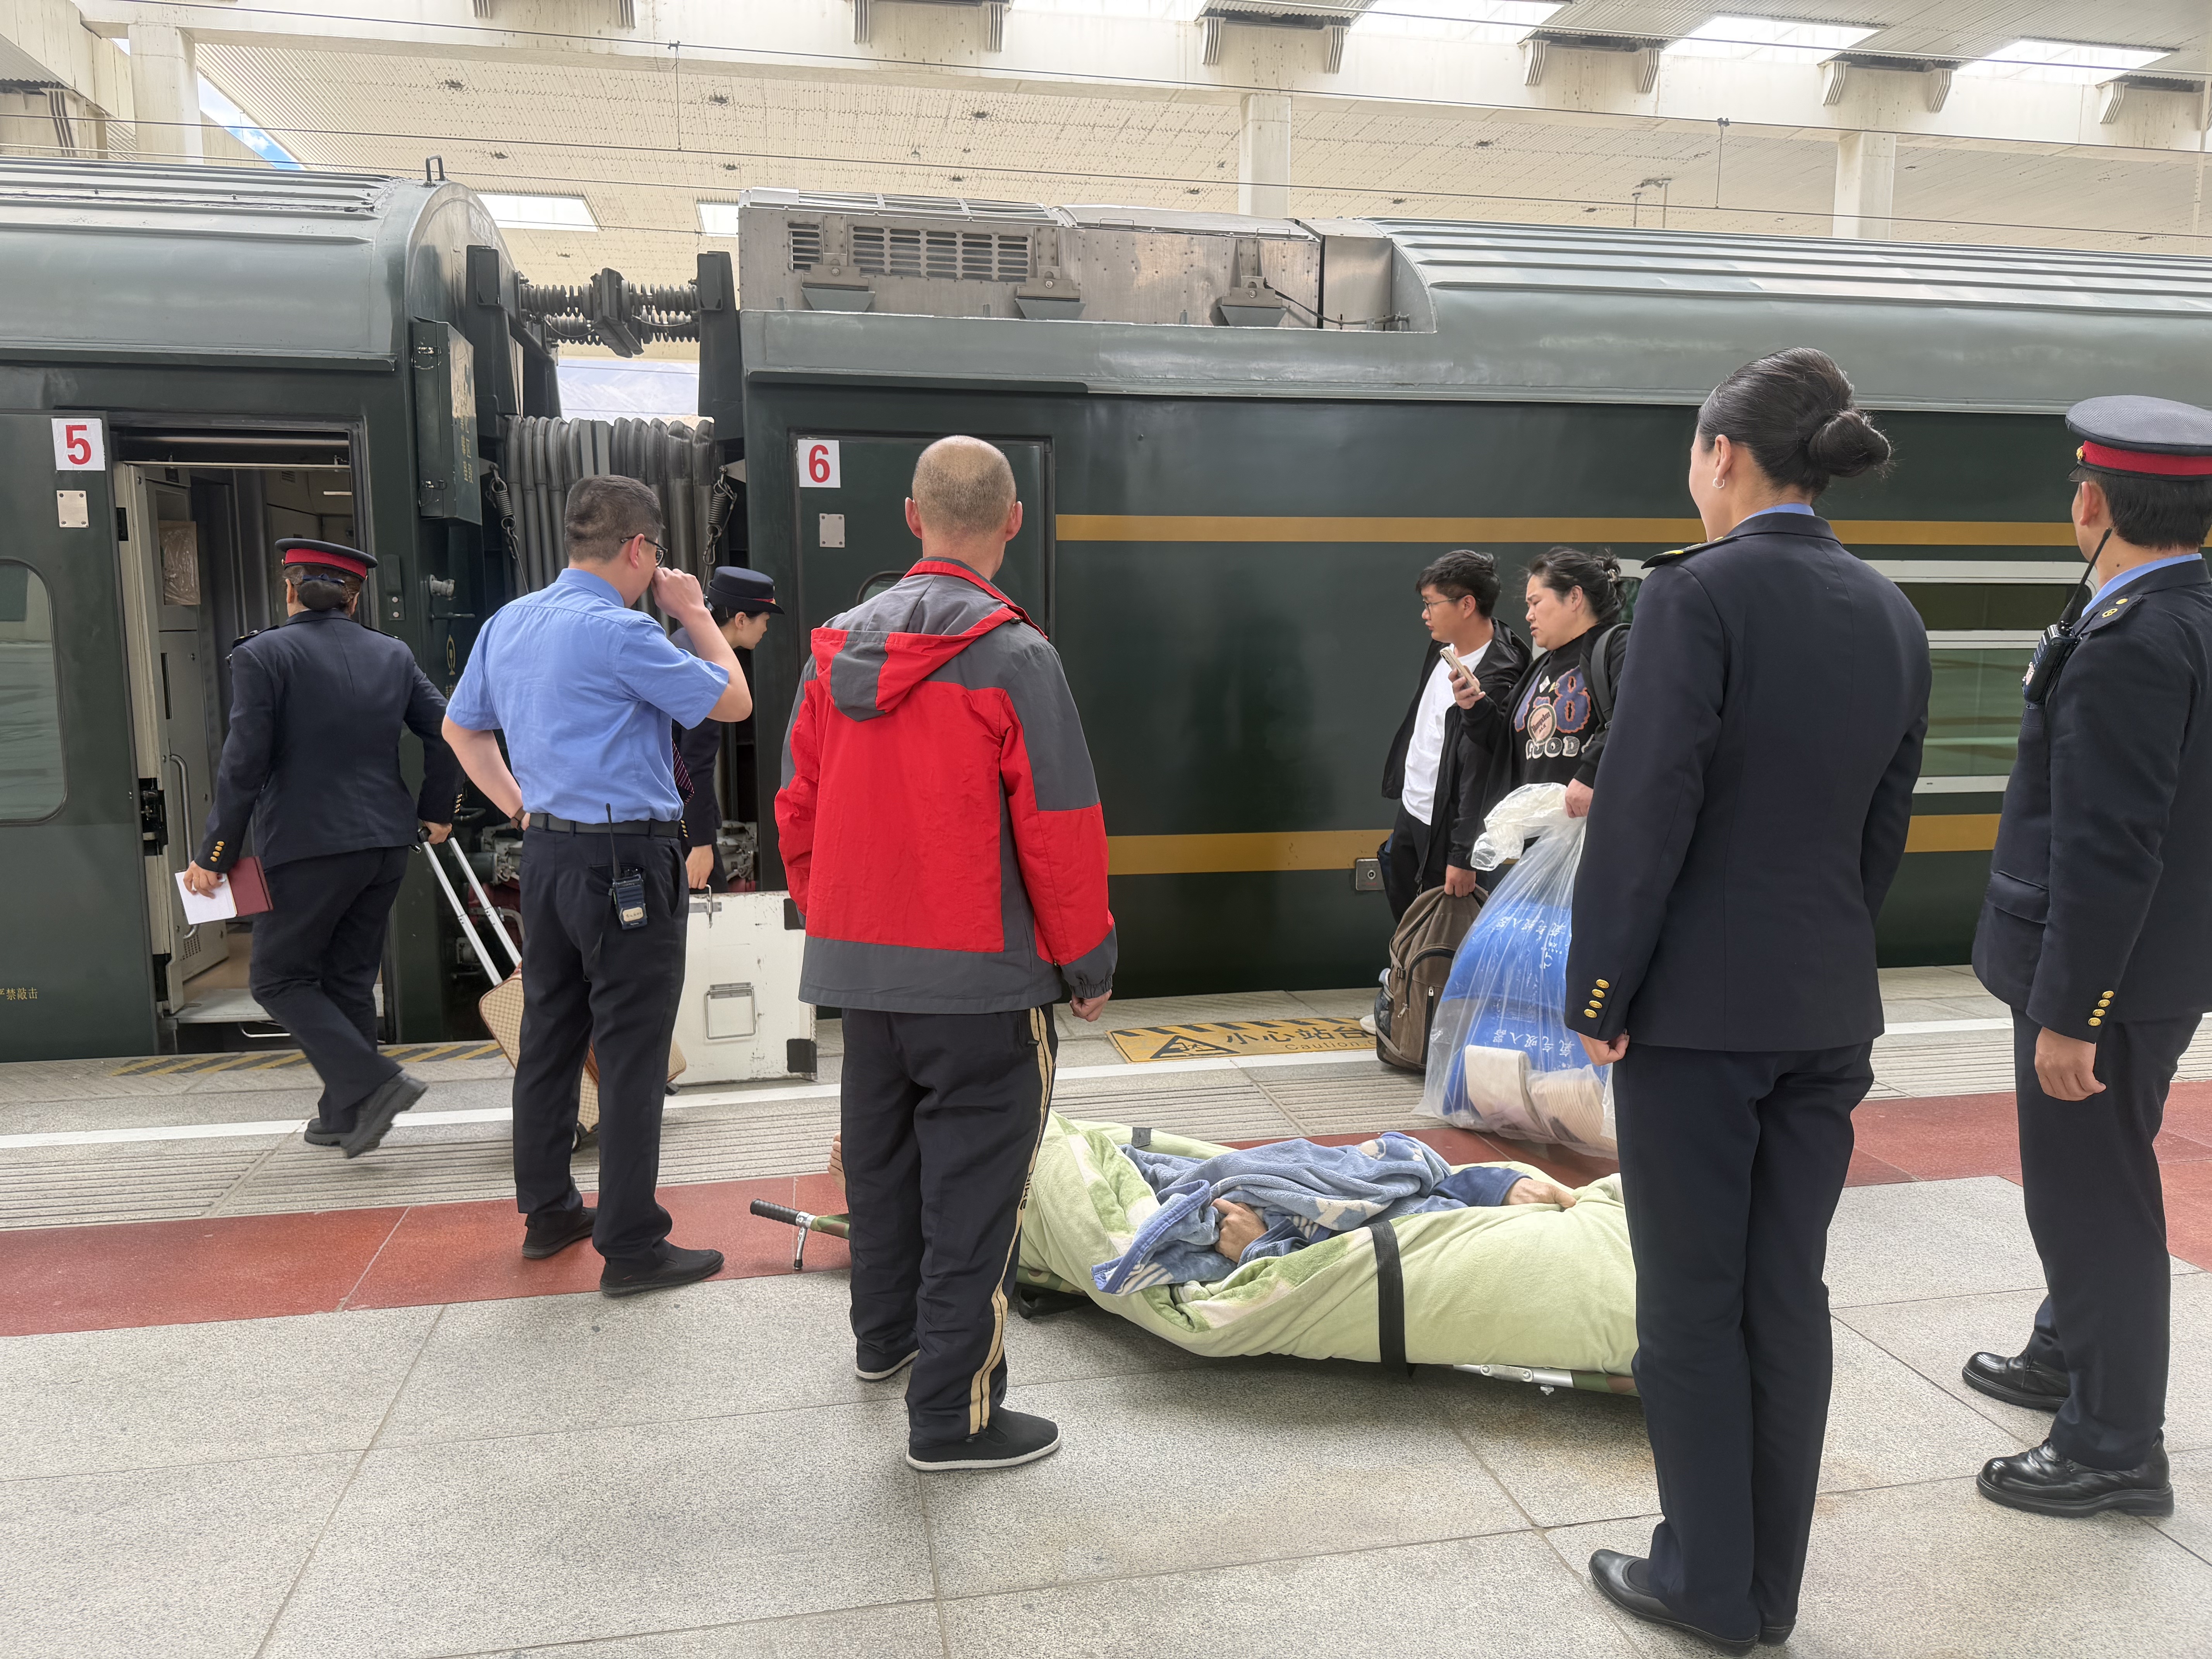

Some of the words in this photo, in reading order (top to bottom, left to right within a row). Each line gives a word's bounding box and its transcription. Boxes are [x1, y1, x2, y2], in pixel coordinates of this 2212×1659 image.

[65, 424, 91, 465] 5
[809, 445, 830, 483] 6
[1493, 1029, 1575, 1057] 氧气吸入器
[1019, 1172, 1033, 1210] NIKE
